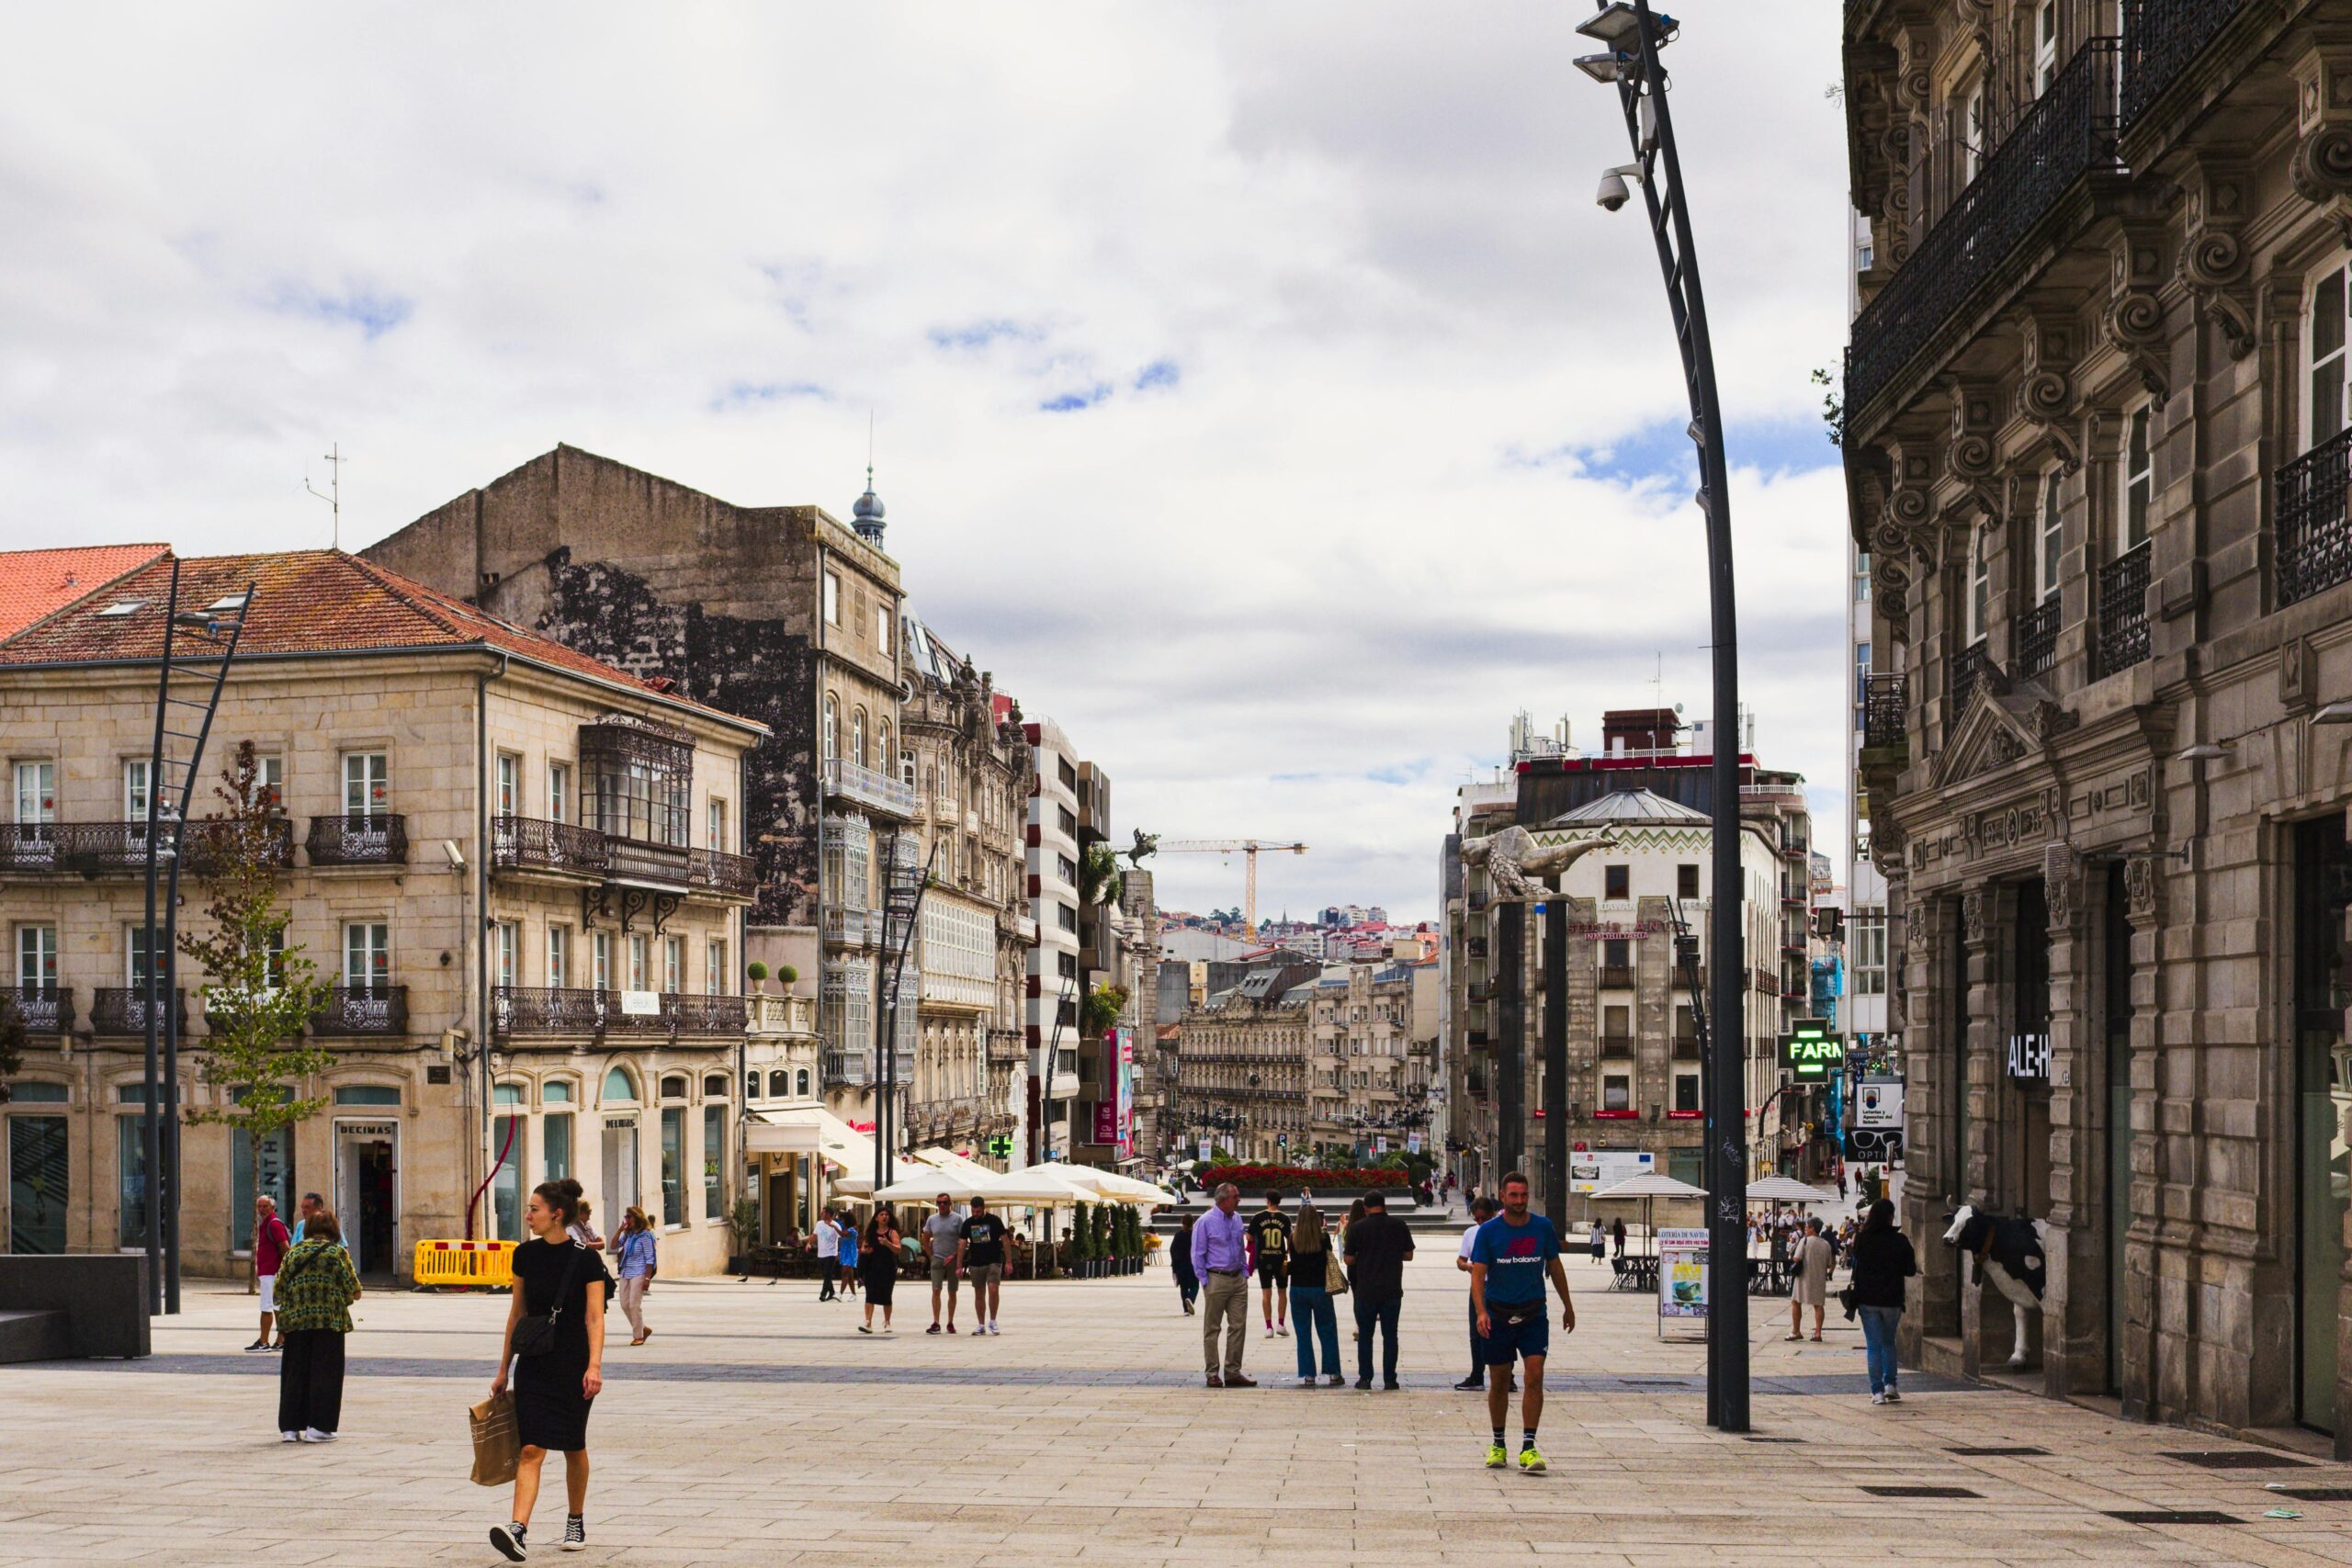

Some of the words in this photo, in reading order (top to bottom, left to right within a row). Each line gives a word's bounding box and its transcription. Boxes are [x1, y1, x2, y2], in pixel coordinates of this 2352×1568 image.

[2007, 1034, 2052, 1077] ALE-H
[341, 1125, 391, 1134] DECIMAS
[1262, 1228, 1282, 1248] 10
